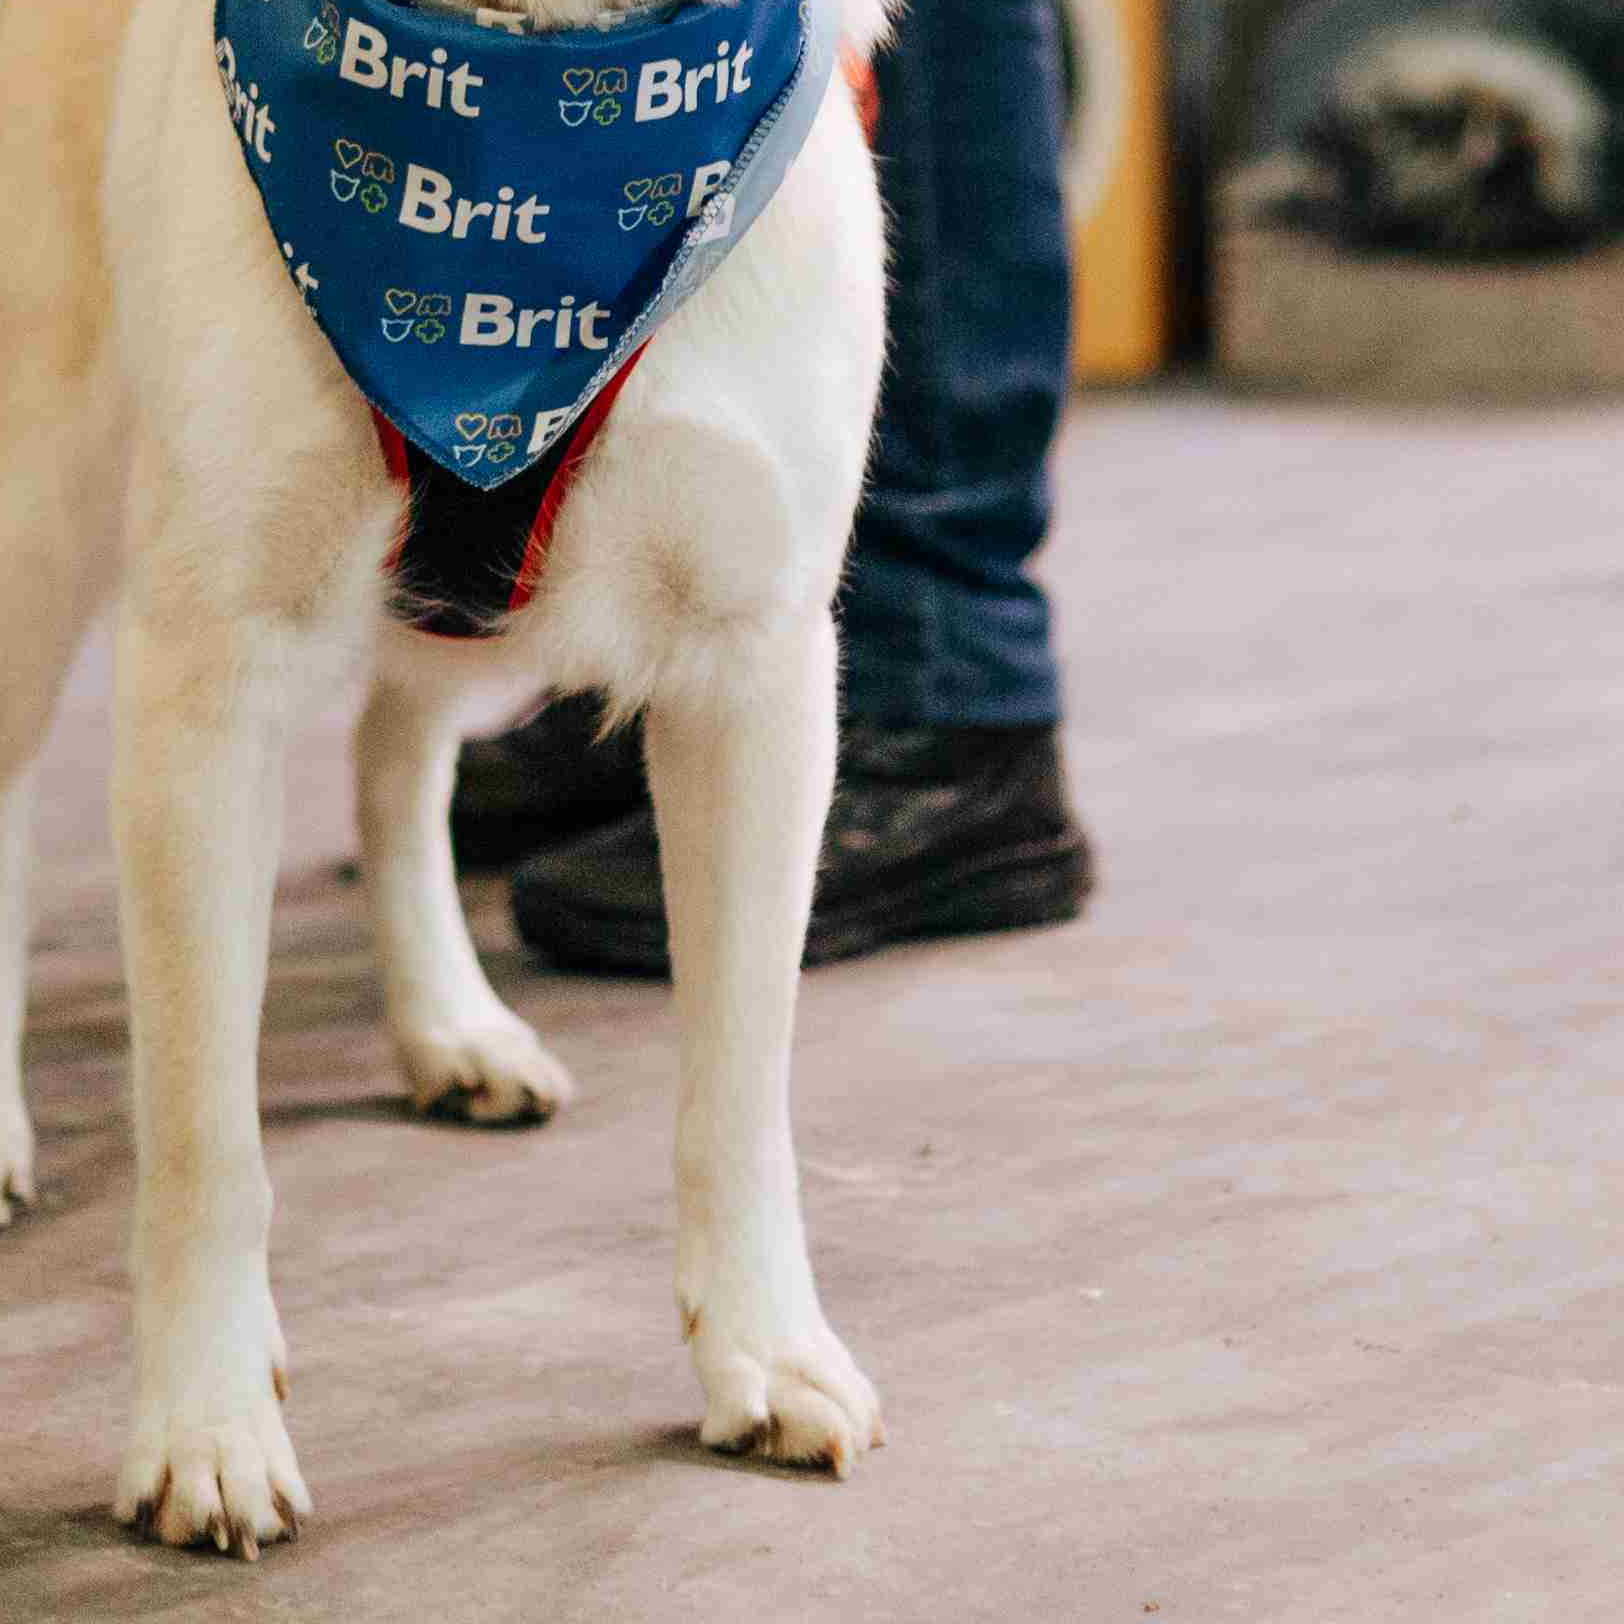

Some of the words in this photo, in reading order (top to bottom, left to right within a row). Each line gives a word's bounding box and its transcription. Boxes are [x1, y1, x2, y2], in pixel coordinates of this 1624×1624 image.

[337, 16, 486, 120] Brit
[634, 38, 754, 124] Brit
[397, 164, 552, 246] Brit
[459, 292, 614, 351] Brit
